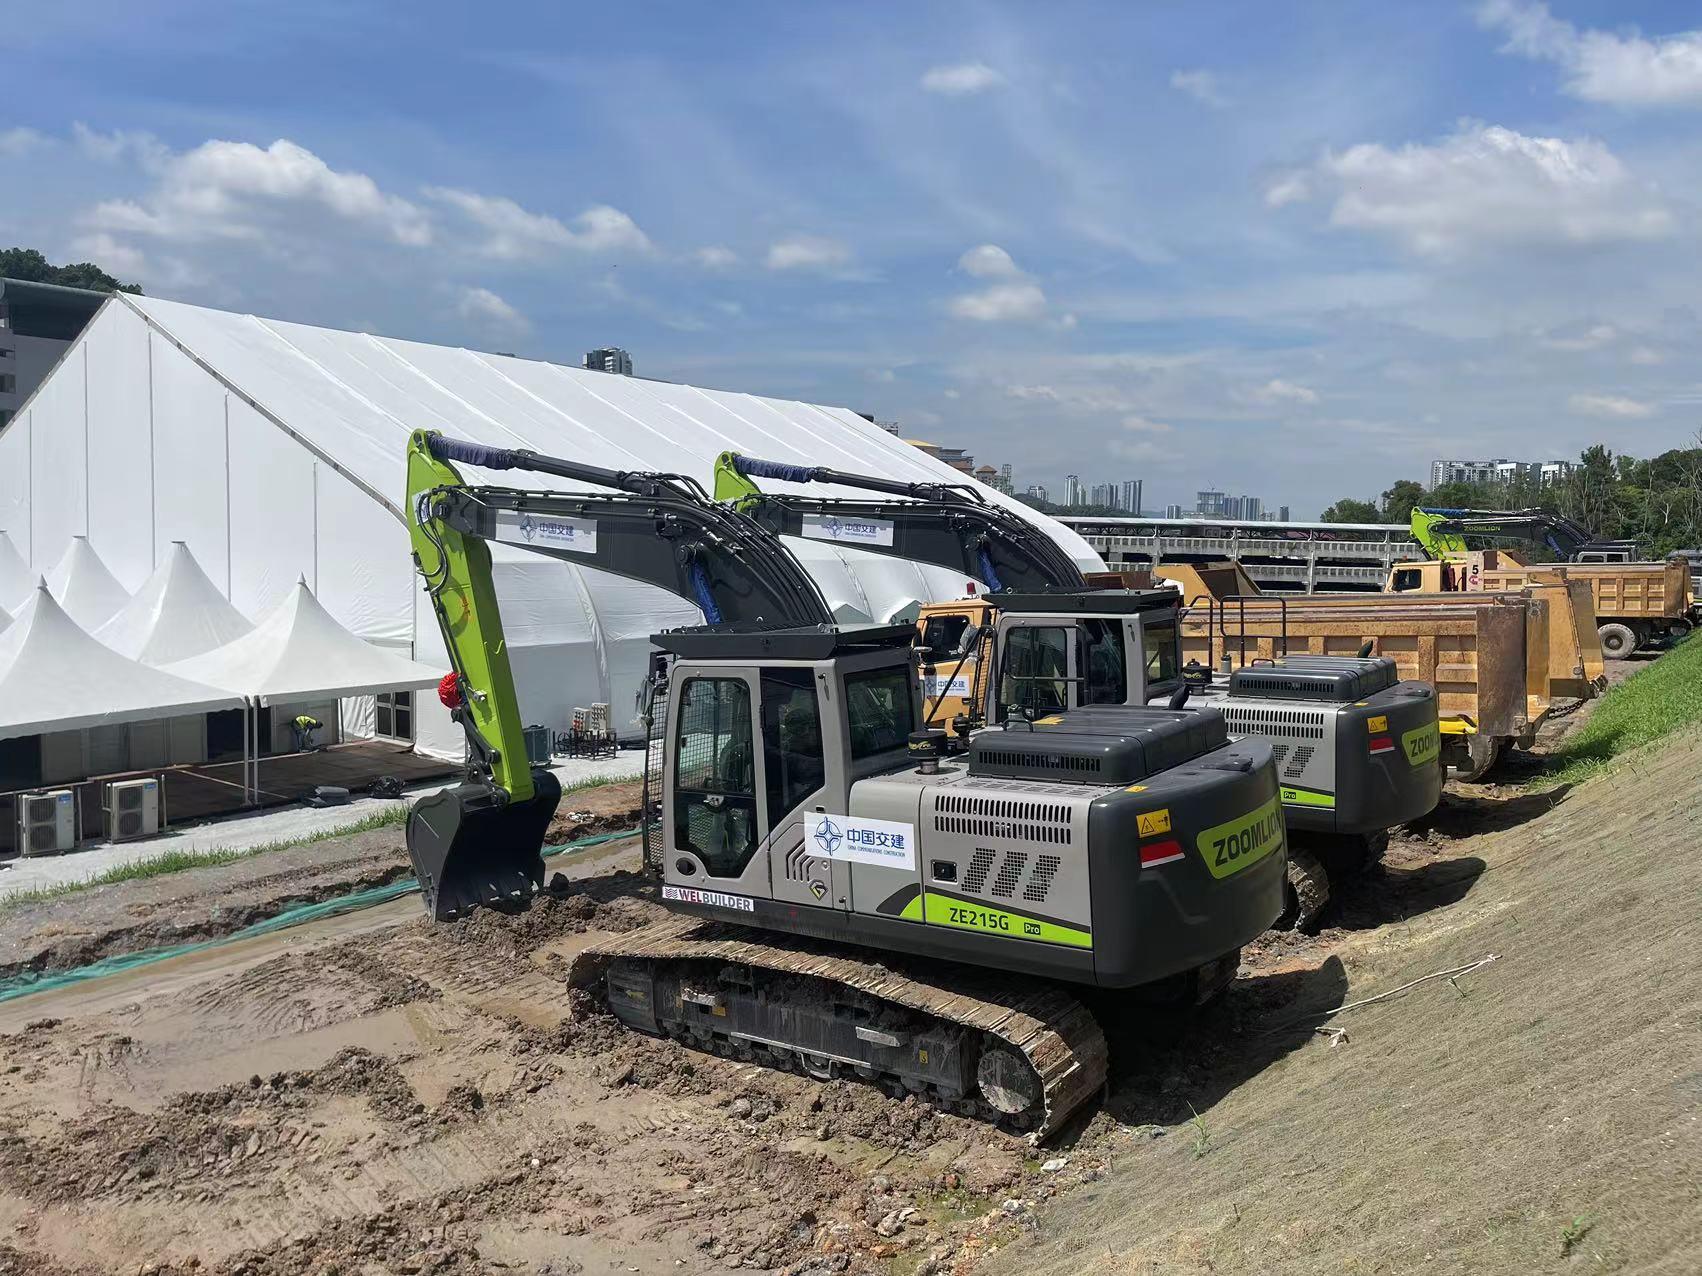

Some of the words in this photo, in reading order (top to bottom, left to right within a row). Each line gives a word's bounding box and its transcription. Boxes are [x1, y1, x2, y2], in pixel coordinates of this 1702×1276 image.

[539, 522, 574, 537] 中国交建
[1472, 564, 1479, 575] 5
[1284, 791, 1296, 799] Pro
[847, 828, 905, 850] 中国交建
[1212, 809, 1283, 867] ZOOMLION
[678, 889, 751, 911] WELBUILDER
[949, 907, 1009, 931] ZE215G
[1024, 923, 1040, 935] Pro
